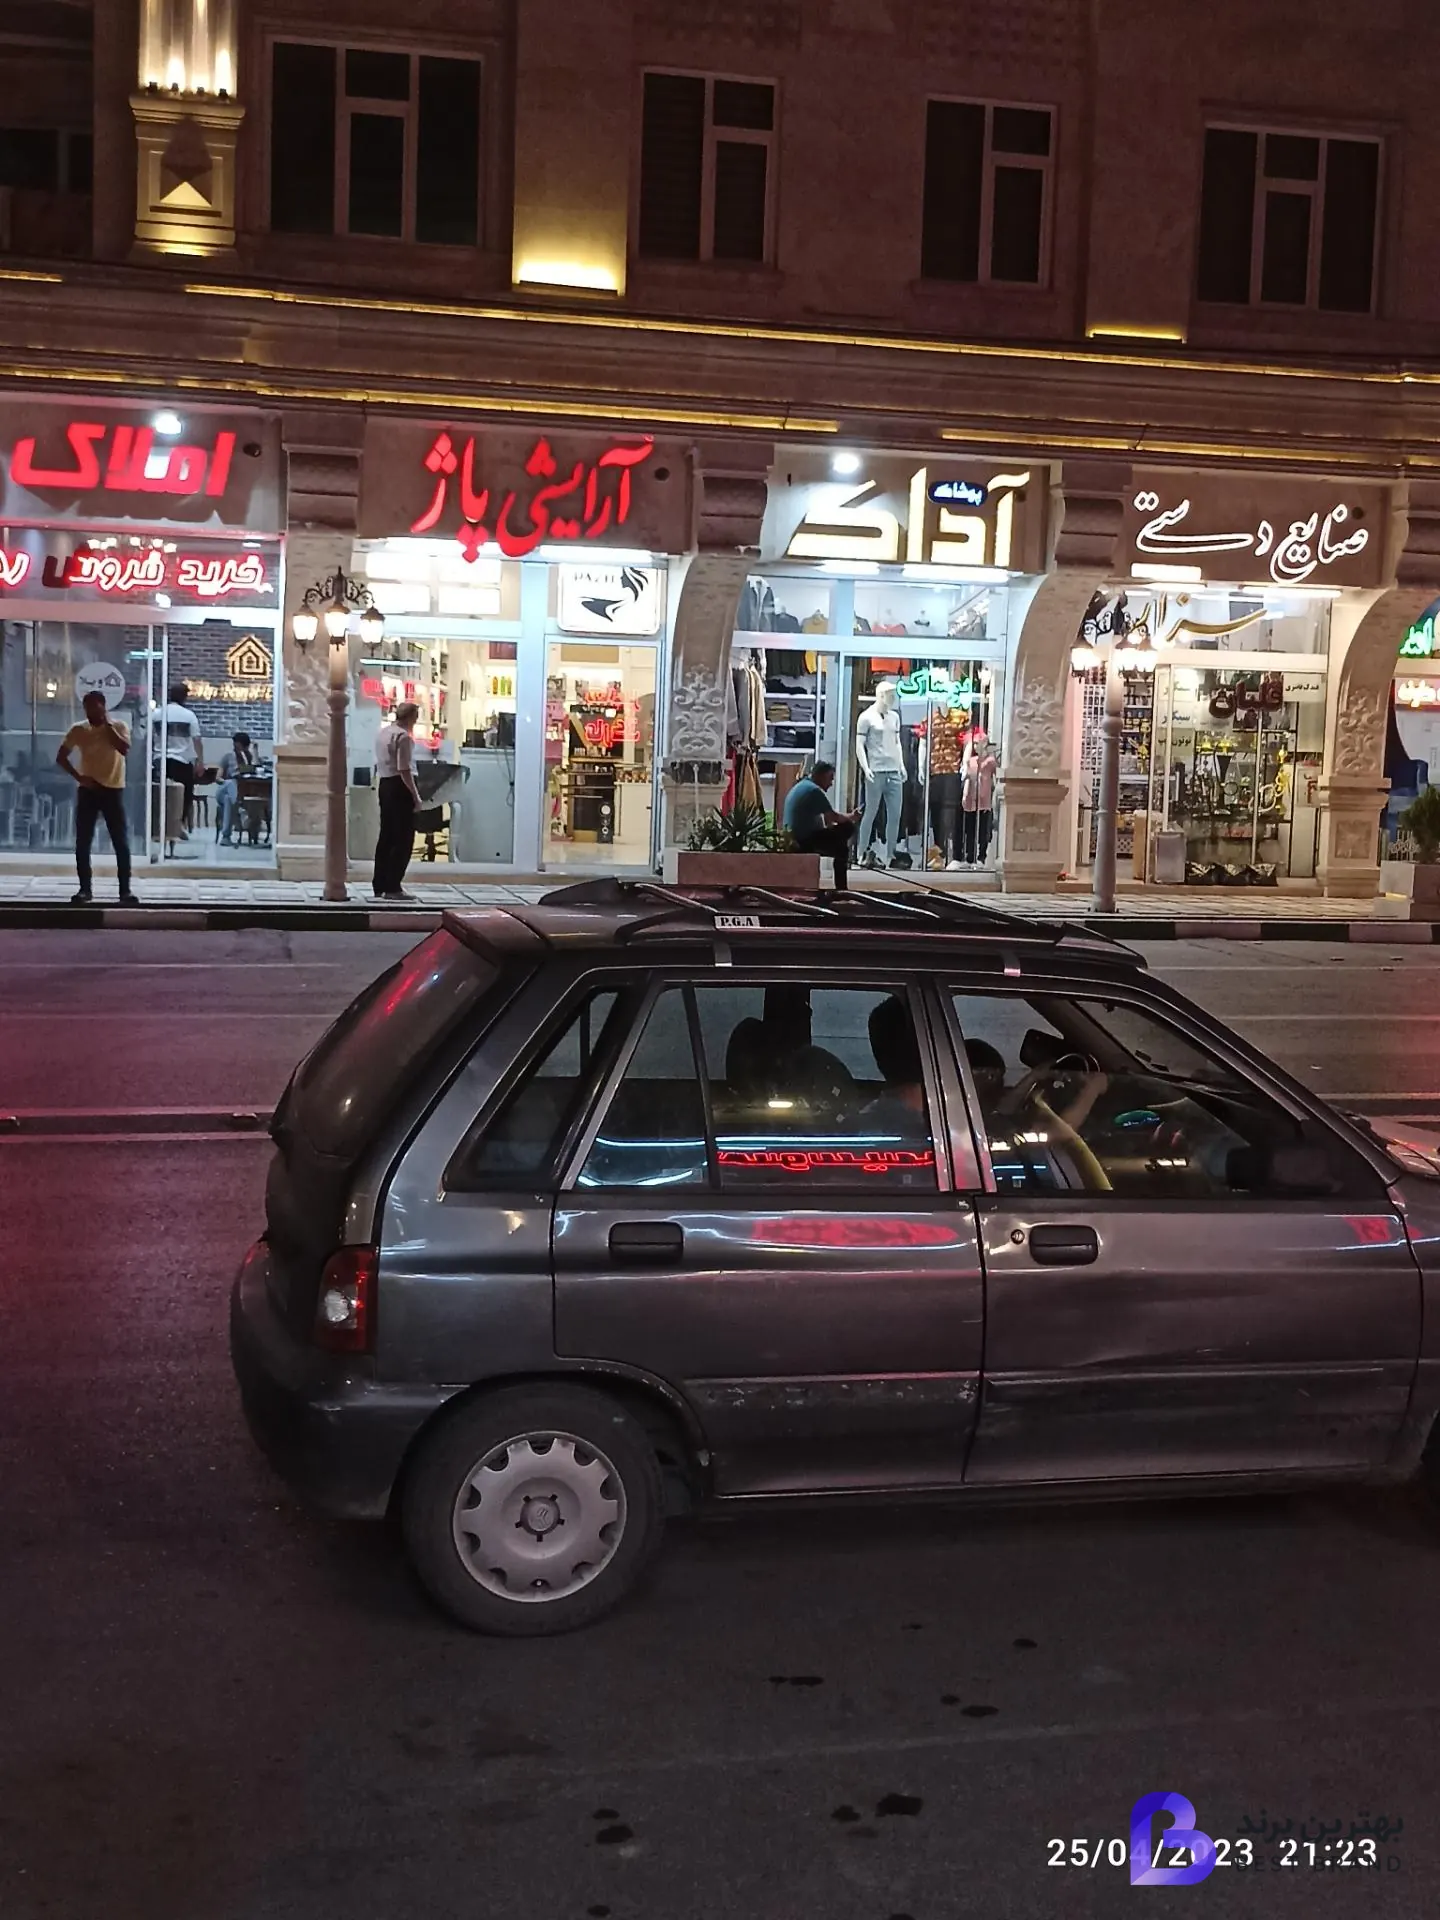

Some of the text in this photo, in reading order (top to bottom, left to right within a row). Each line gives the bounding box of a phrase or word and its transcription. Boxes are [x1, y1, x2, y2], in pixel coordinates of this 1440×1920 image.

[10, 422, 236, 496] املاک
[496, 434, 654, 557] آرایشی
[177, 554, 275, 596] خرید
[1133, 490, 1369, 584] صنایع دستی
